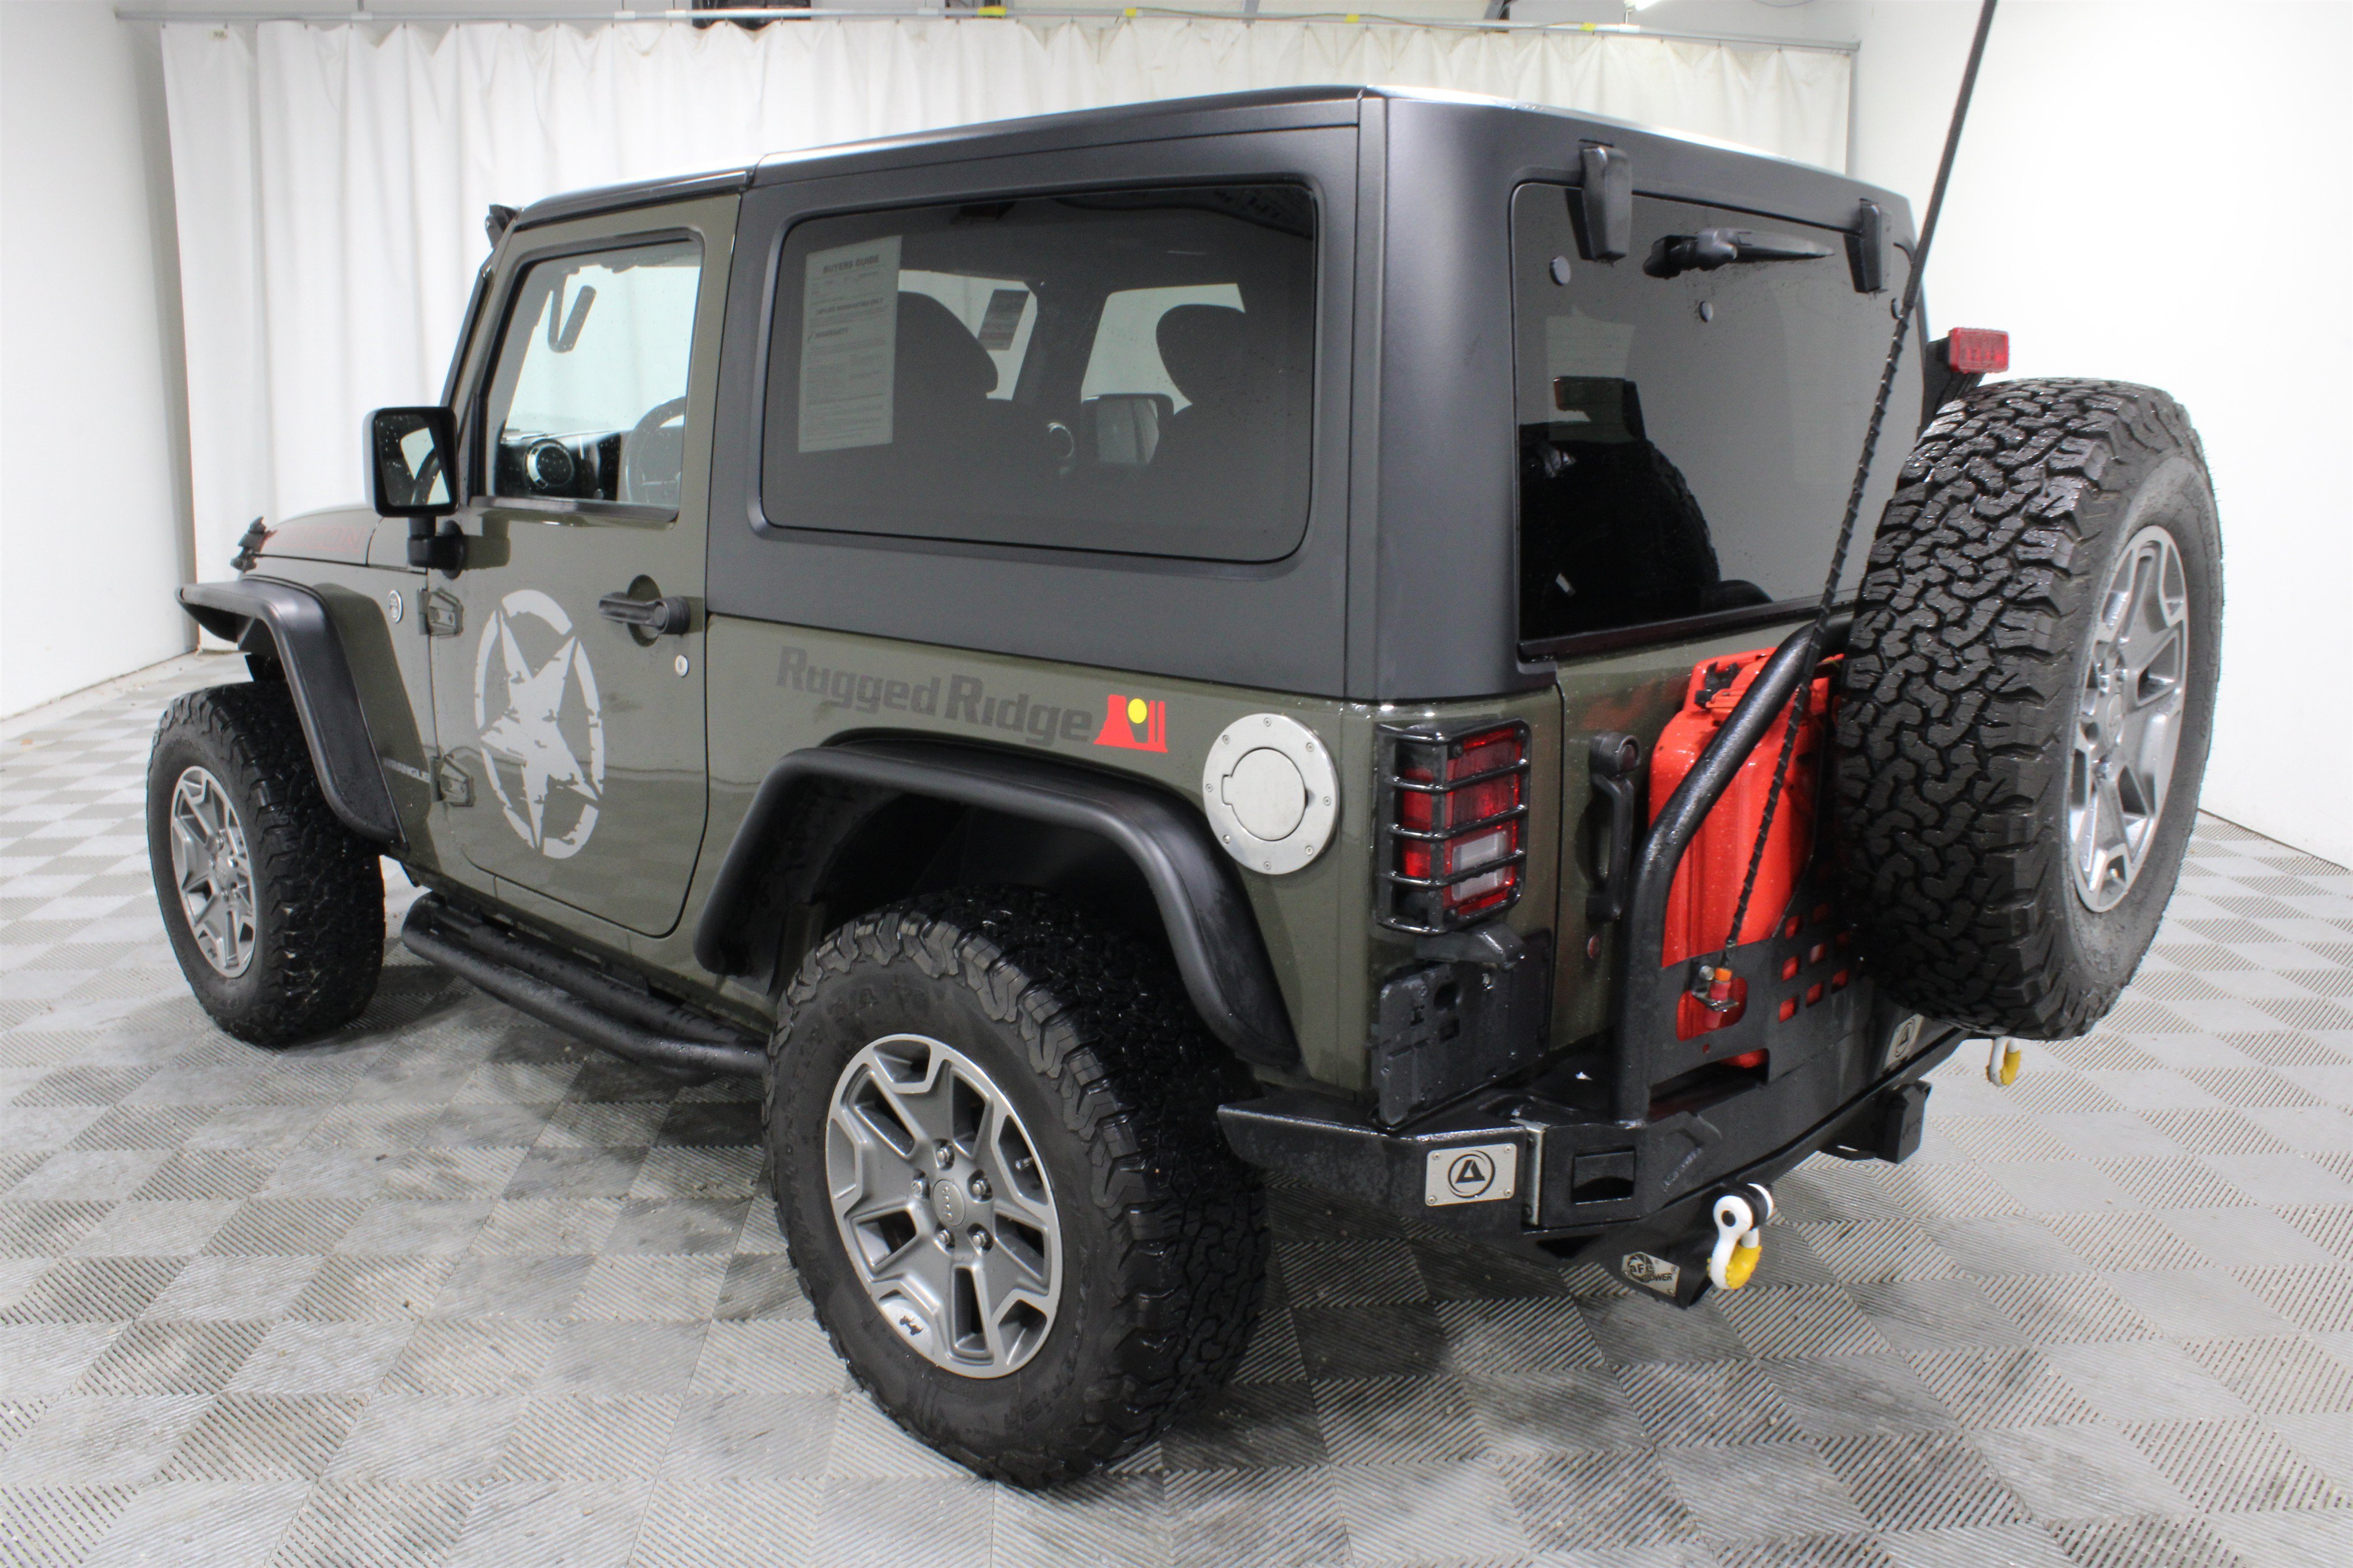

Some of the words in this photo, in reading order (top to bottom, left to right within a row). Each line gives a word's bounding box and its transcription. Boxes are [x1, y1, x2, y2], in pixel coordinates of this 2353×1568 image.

[823, 260, 853, 274] BUYERS
[855, 254, 880, 267] GUIDE
[776, 646, 941, 716] Rugged
[944, 674, 1092, 746] Ridge
